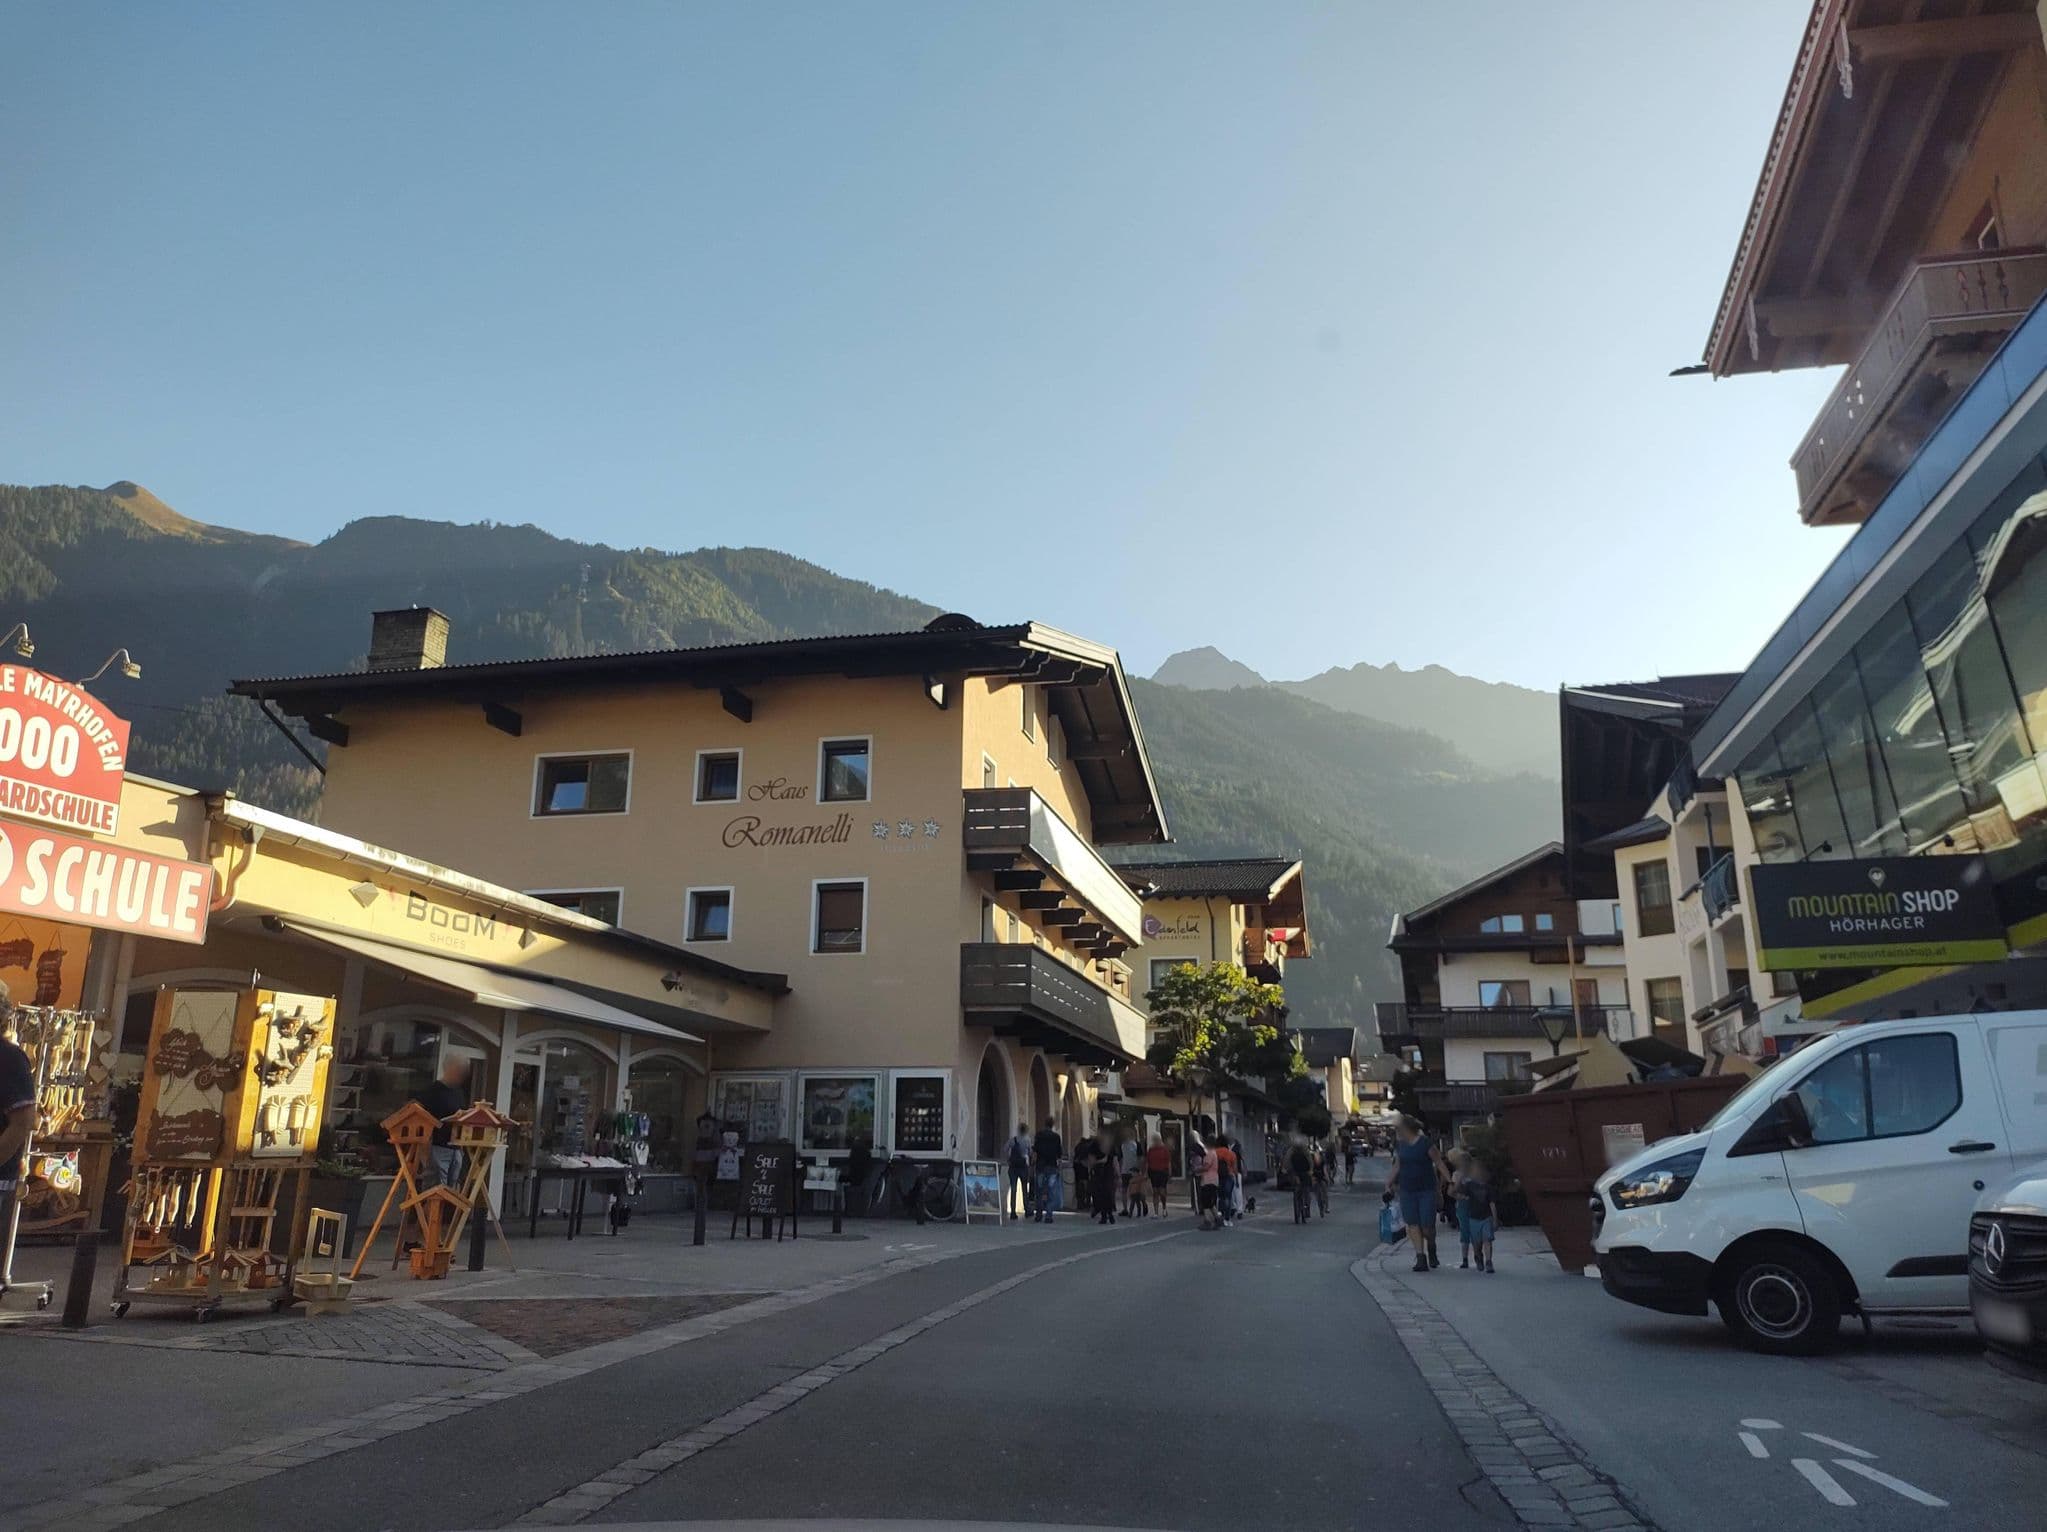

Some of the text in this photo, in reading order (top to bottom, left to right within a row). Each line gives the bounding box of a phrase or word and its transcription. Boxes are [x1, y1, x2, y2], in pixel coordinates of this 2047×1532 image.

[24, 672, 124, 772] MAYRHOFEN
[748, 777, 808, 801] Haus
[722, 813, 854, 848] Romanelli
[20, 838, 203, 933] SCHULE
[1902, 889, 1959, 914] SHOP
[1829, 916, 1925, 933] HÖRHAGER
[429, 933, 466, 950] SHOES
[754, 1154, 779, 1169] SALE
